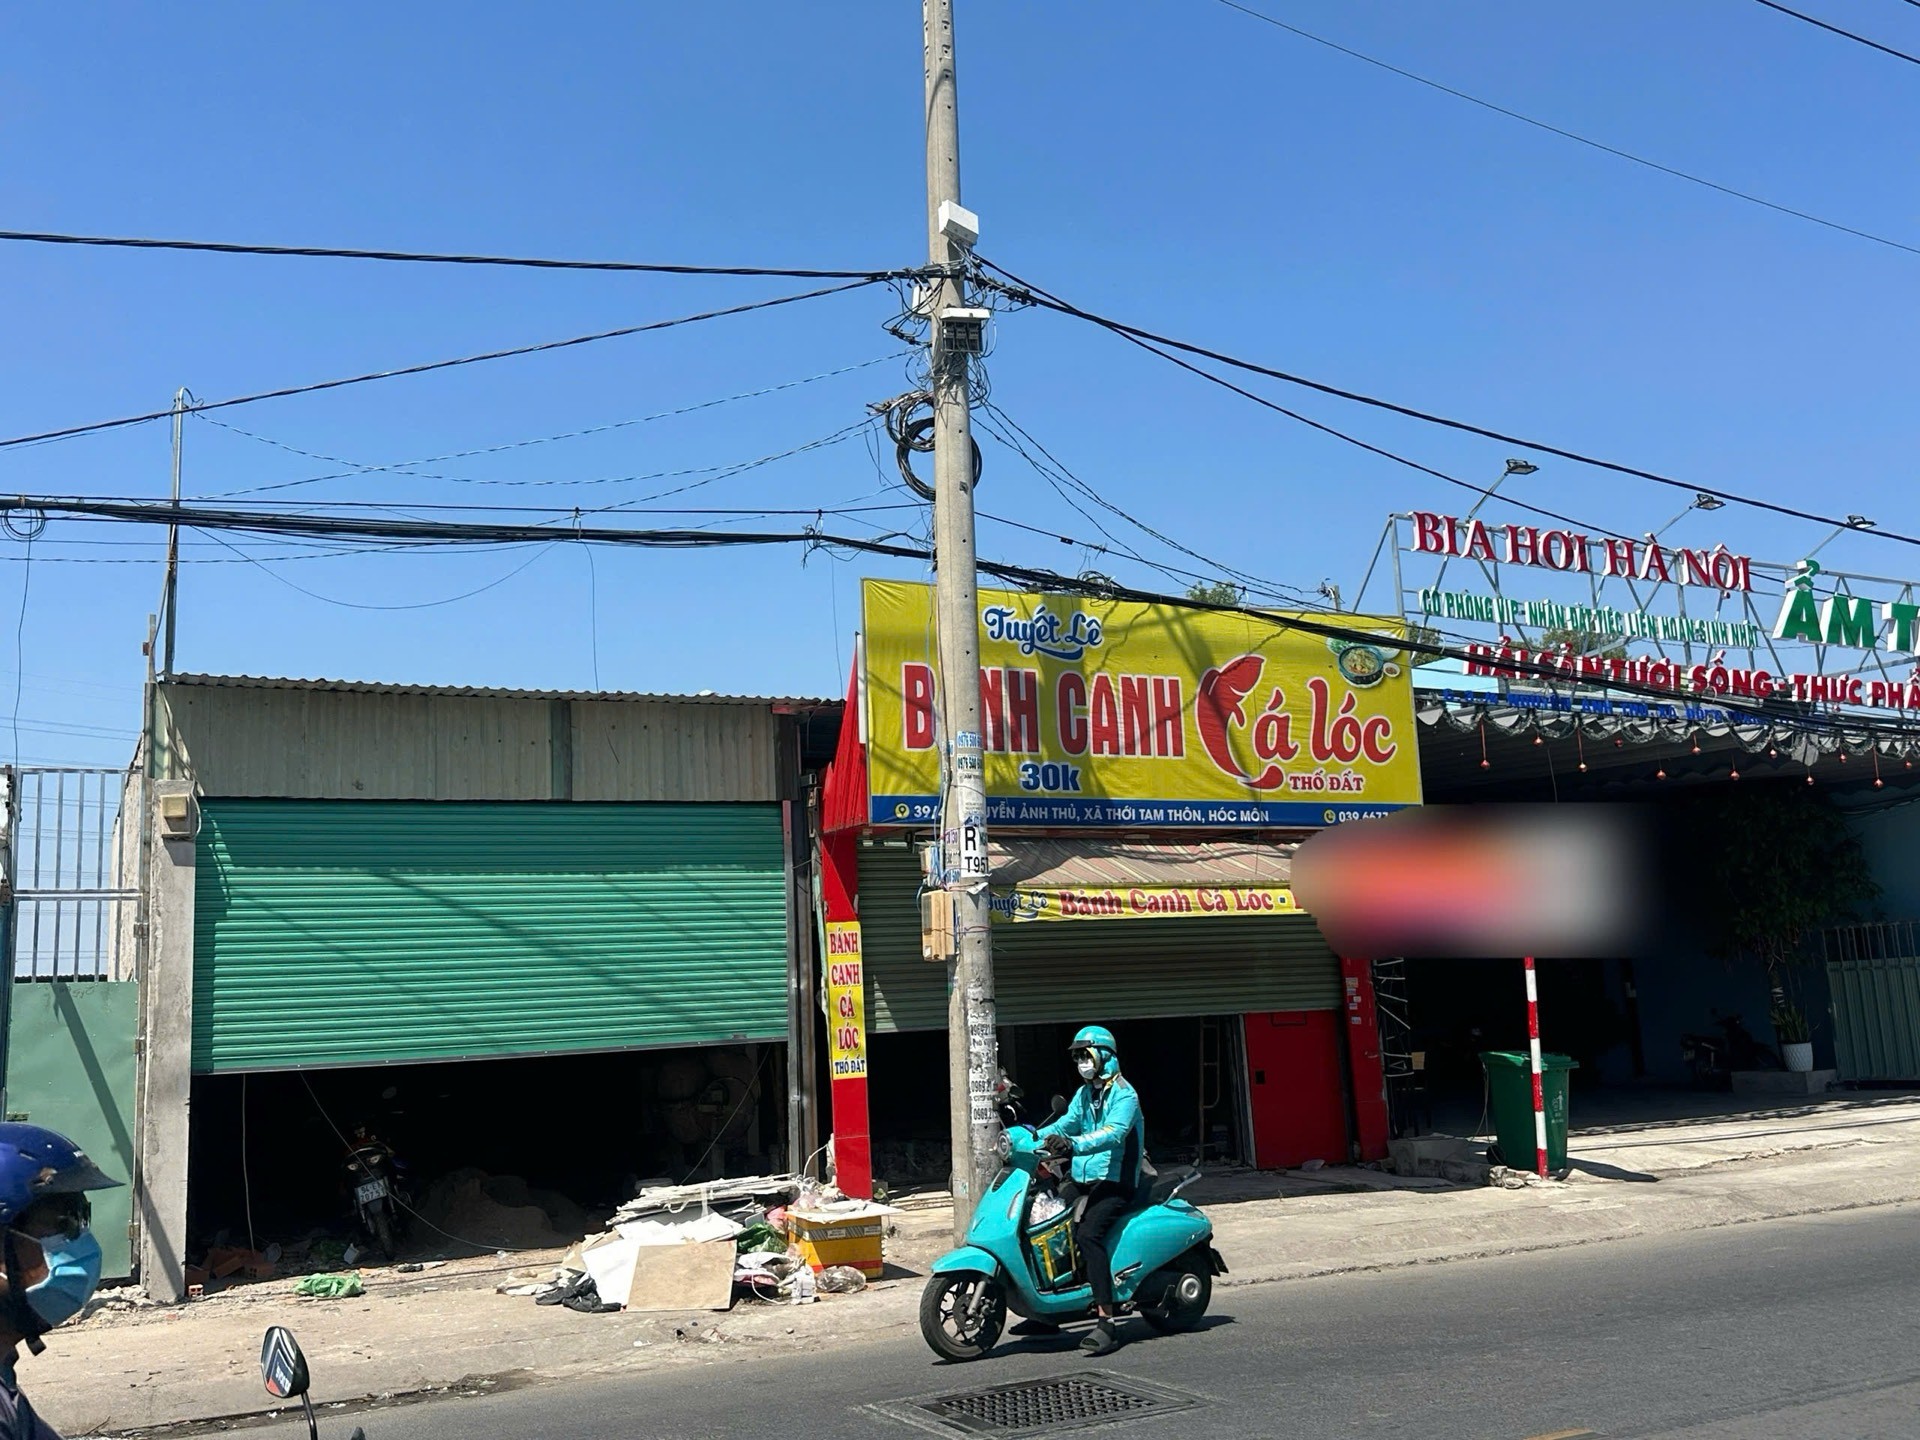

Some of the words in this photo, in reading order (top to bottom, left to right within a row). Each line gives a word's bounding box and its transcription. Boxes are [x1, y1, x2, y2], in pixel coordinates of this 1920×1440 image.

[1408, 511, 1498, 562] BIA
[1501, 524, 1592, 573] HƠI
[1599, 533, 1672, 583] HÀ
[1676, 543, 1755, 599] NỘI
[1419, 586, 1441, 616] CÓ
[1442, 589, 1493, 623] PHÒNG
[1493, 598, 1518, 624] VIP
[1772, 559, 1877, 650] ẨM
[1882, 602, 1920, 657] T
[984, 605, 1062, 656] Tuyết
[1065, 613, 1102, 647] Lê
[1789, 674, 1863, 713] THỰC
[904, 664, 1039, 753] BNH
[1057, 672, 1184, 757] CANH
[1308, 679, 1396, 763] lóc
[1021, 764, 1080, 791] 30k
[1290, 771, 1325, 791] THỐ
[1329, 771, 1364, 791] ĐẤT
[1019, 802, 1048, 819] ẢNH
[1084, 805, 1103, 820] XÃ
[1106, 805, 1136, 821] THỚI
[1139, 808, 1164, 821] TAM
[1167, 806, 1205, 824] THÔN,
[1208, 806, 1237, 822] HÓC
[1240, 807, 1270, 822] MÔN
[964, 826, 977, 851] R
[1130, 888, 1192, 913] Canh
[830, 927, 858, 954] BÁNH
[831, 963, 860, 986] CANH
[840, 990, 855, 1017] CÁ
[839, 1022, 859, 1050] LÓC
